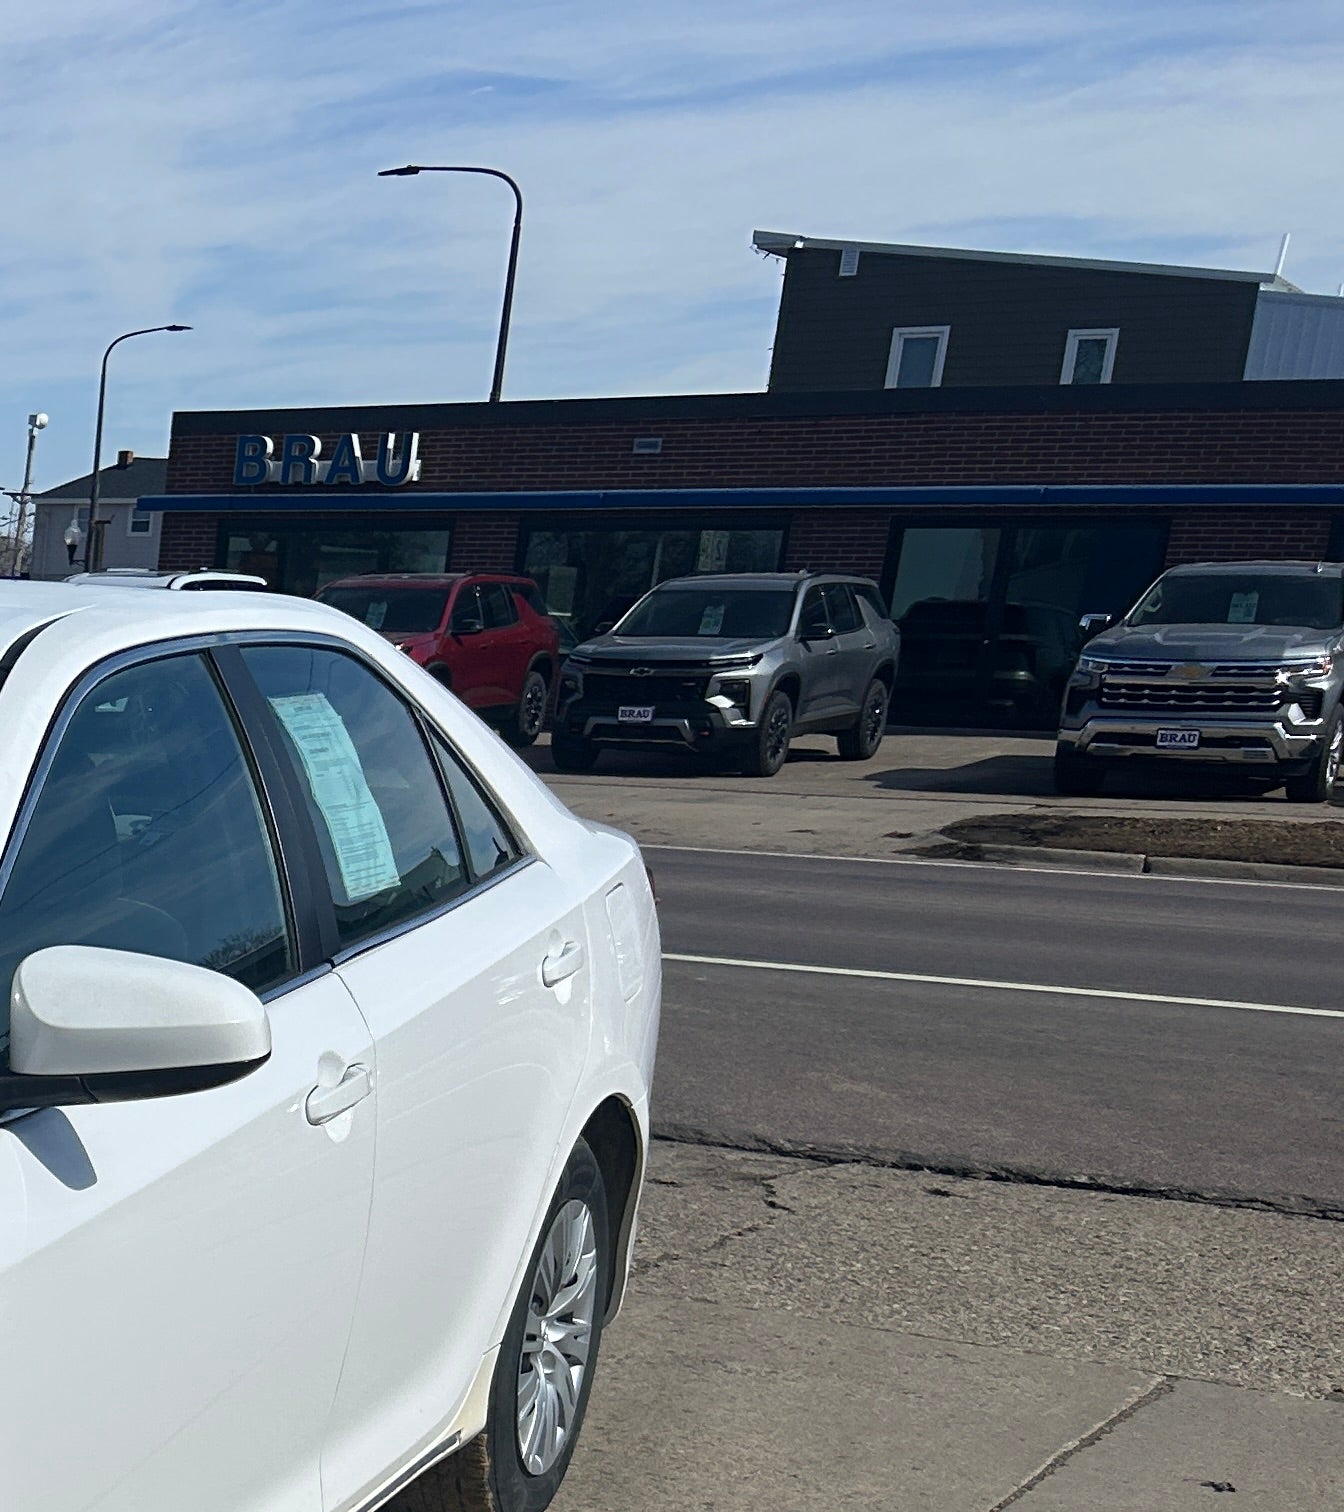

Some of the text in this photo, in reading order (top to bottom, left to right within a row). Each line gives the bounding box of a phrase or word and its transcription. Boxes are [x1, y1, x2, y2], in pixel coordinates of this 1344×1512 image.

[233, 432, 419, 487] BRAU
[619, 708, 651, 719] BRAU
[1158, 733, 1198, 744] BRAU
